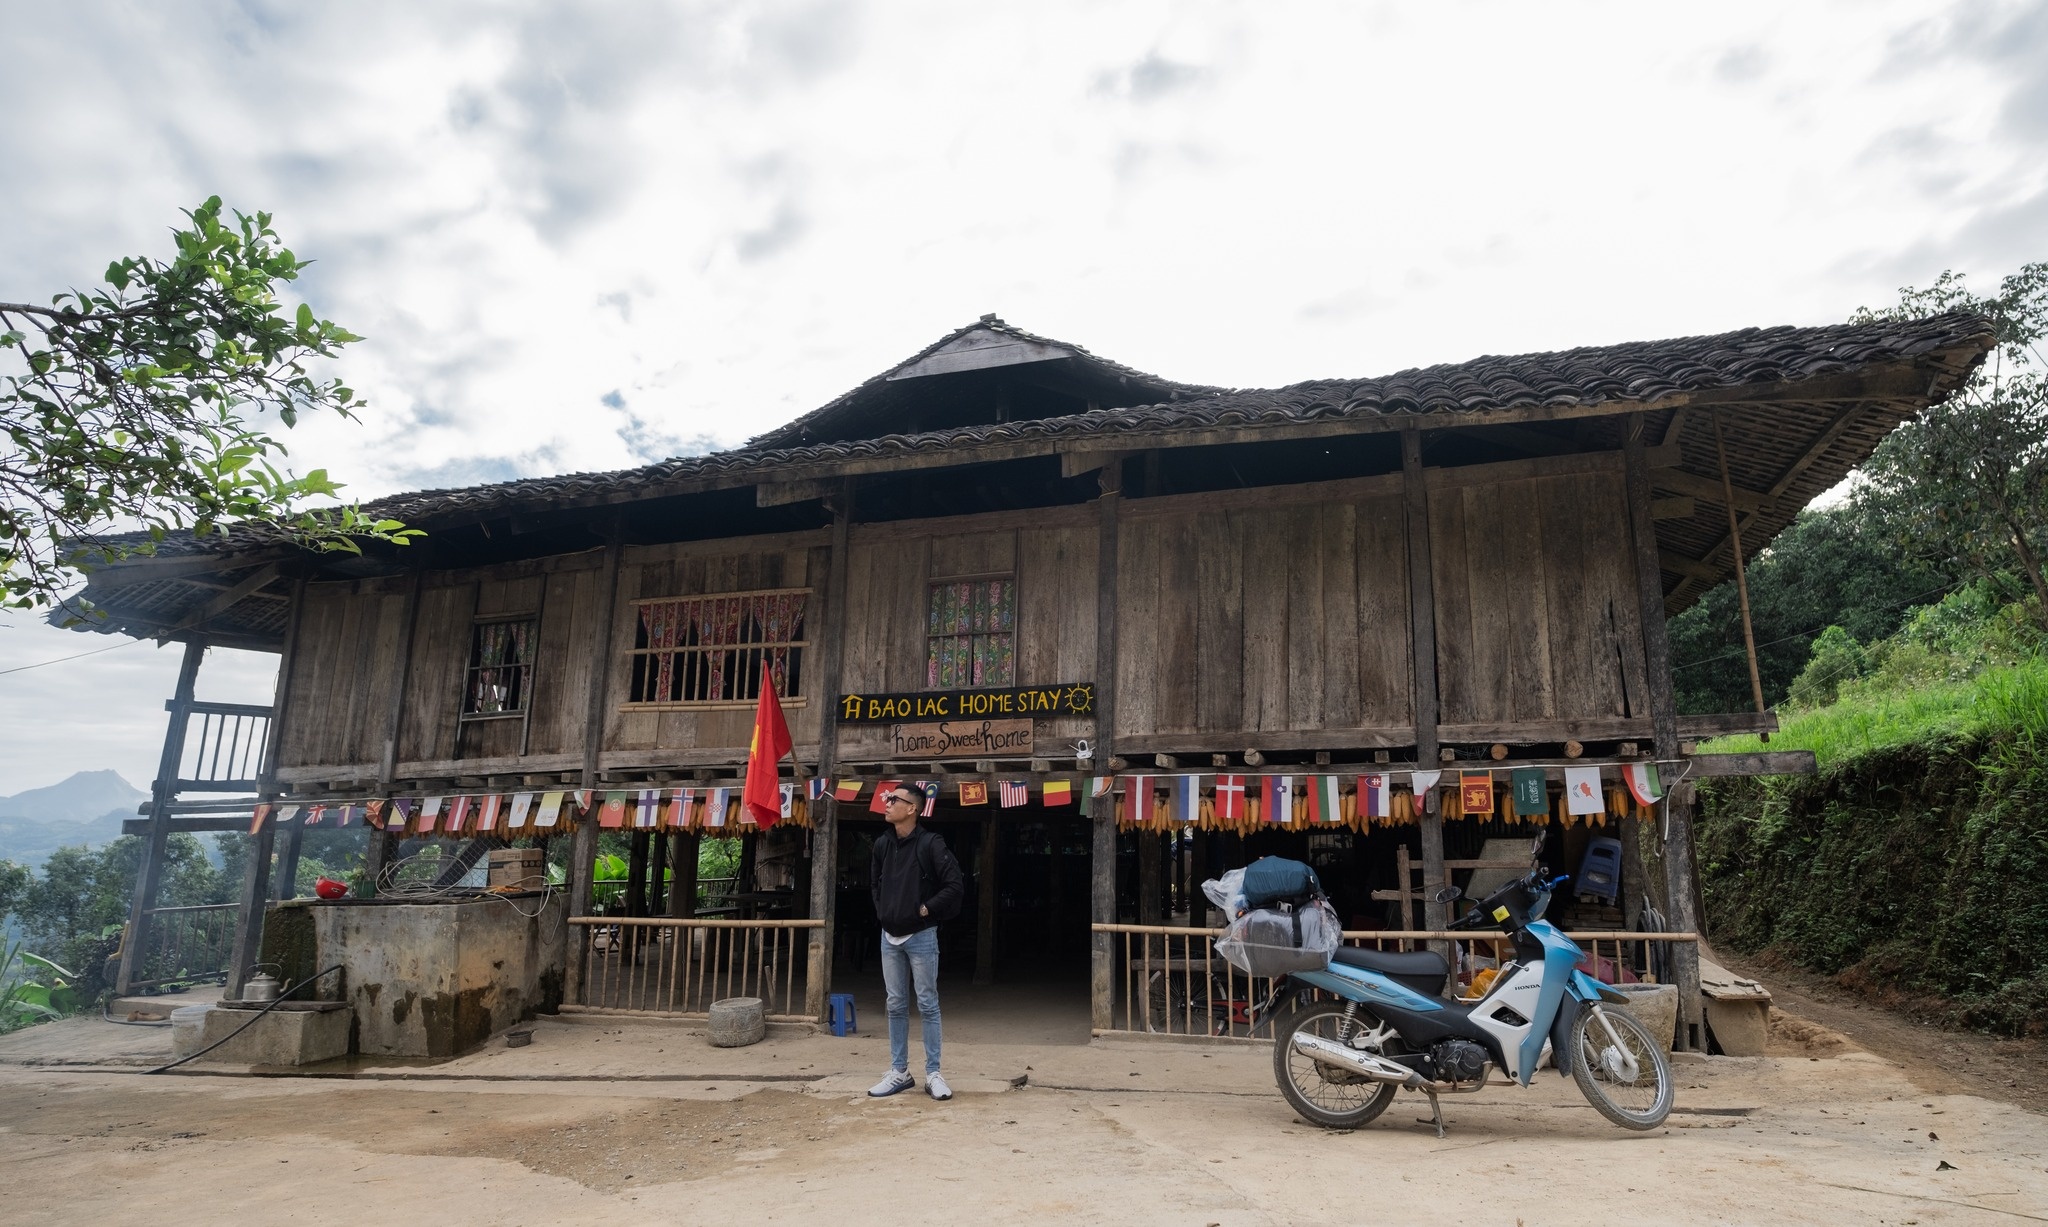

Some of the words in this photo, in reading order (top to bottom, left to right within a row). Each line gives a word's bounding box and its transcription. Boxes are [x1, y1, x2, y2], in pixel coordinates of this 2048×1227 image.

[868, 698, 911, 719] BAO
[917, 696, 949, 717] LAC
[960, 694, 1013, 714] HOME
[1018, 689, 1062, 712] STAY
[891, 724, 936, 754] home
[934, 722, 982, 756] Sweet
[981, 721, 1032, 752] home
[1514, 983, 1541, 991] HONDA
